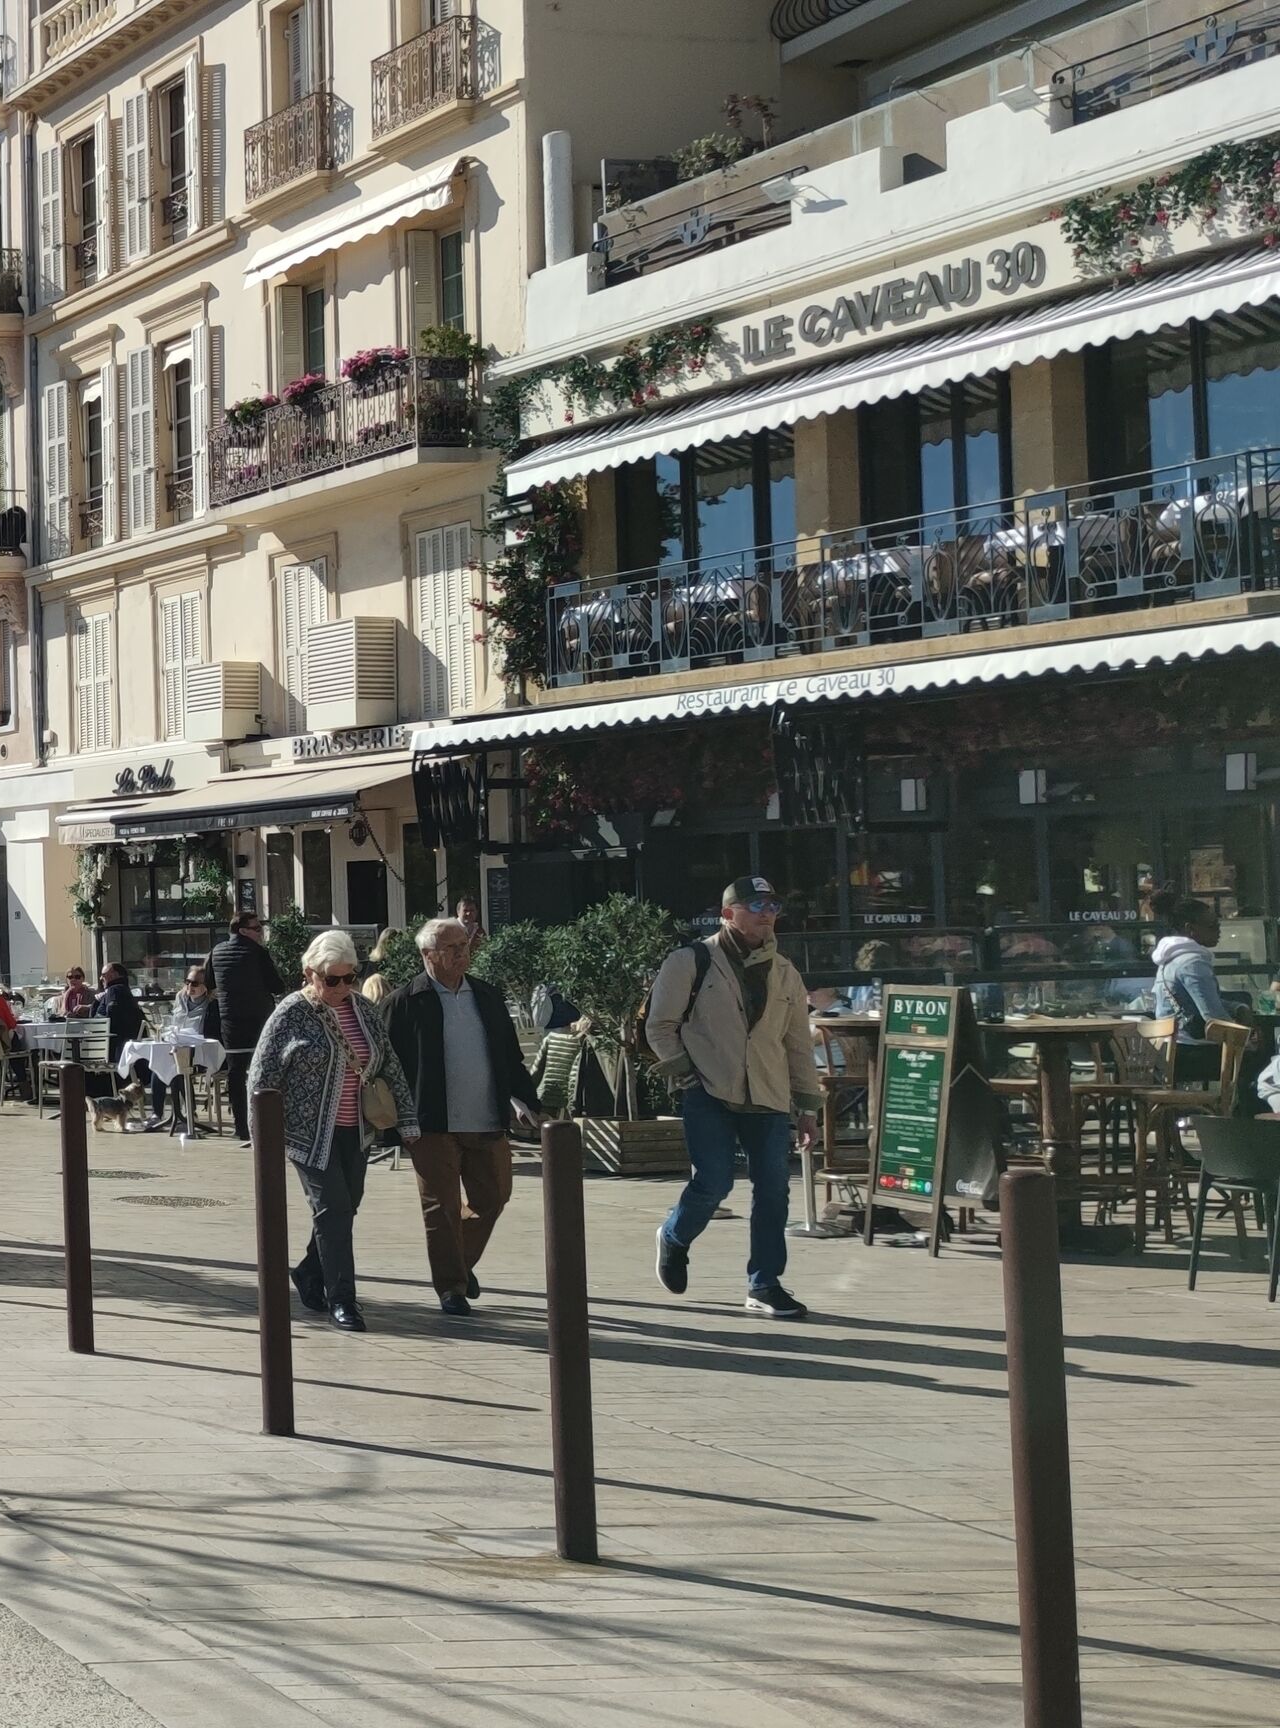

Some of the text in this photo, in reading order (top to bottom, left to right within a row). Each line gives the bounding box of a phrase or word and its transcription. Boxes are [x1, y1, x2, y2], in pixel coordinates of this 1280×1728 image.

[742, 241, 1046, 365] LE CAVEAU 30
[677, 668, 896, 710] Restaurant Le Caveau 30
[293, 726, 406, 757] BRASSERIE
[692, 917, 701, 925] LE
[864, 914, 874, 924] LE
[875, 914, 908, 924] CAVEAU
[1069, 910, 1137, 921] LE CAVEAU 30
[893, 999, 948, 1016] BYRON
